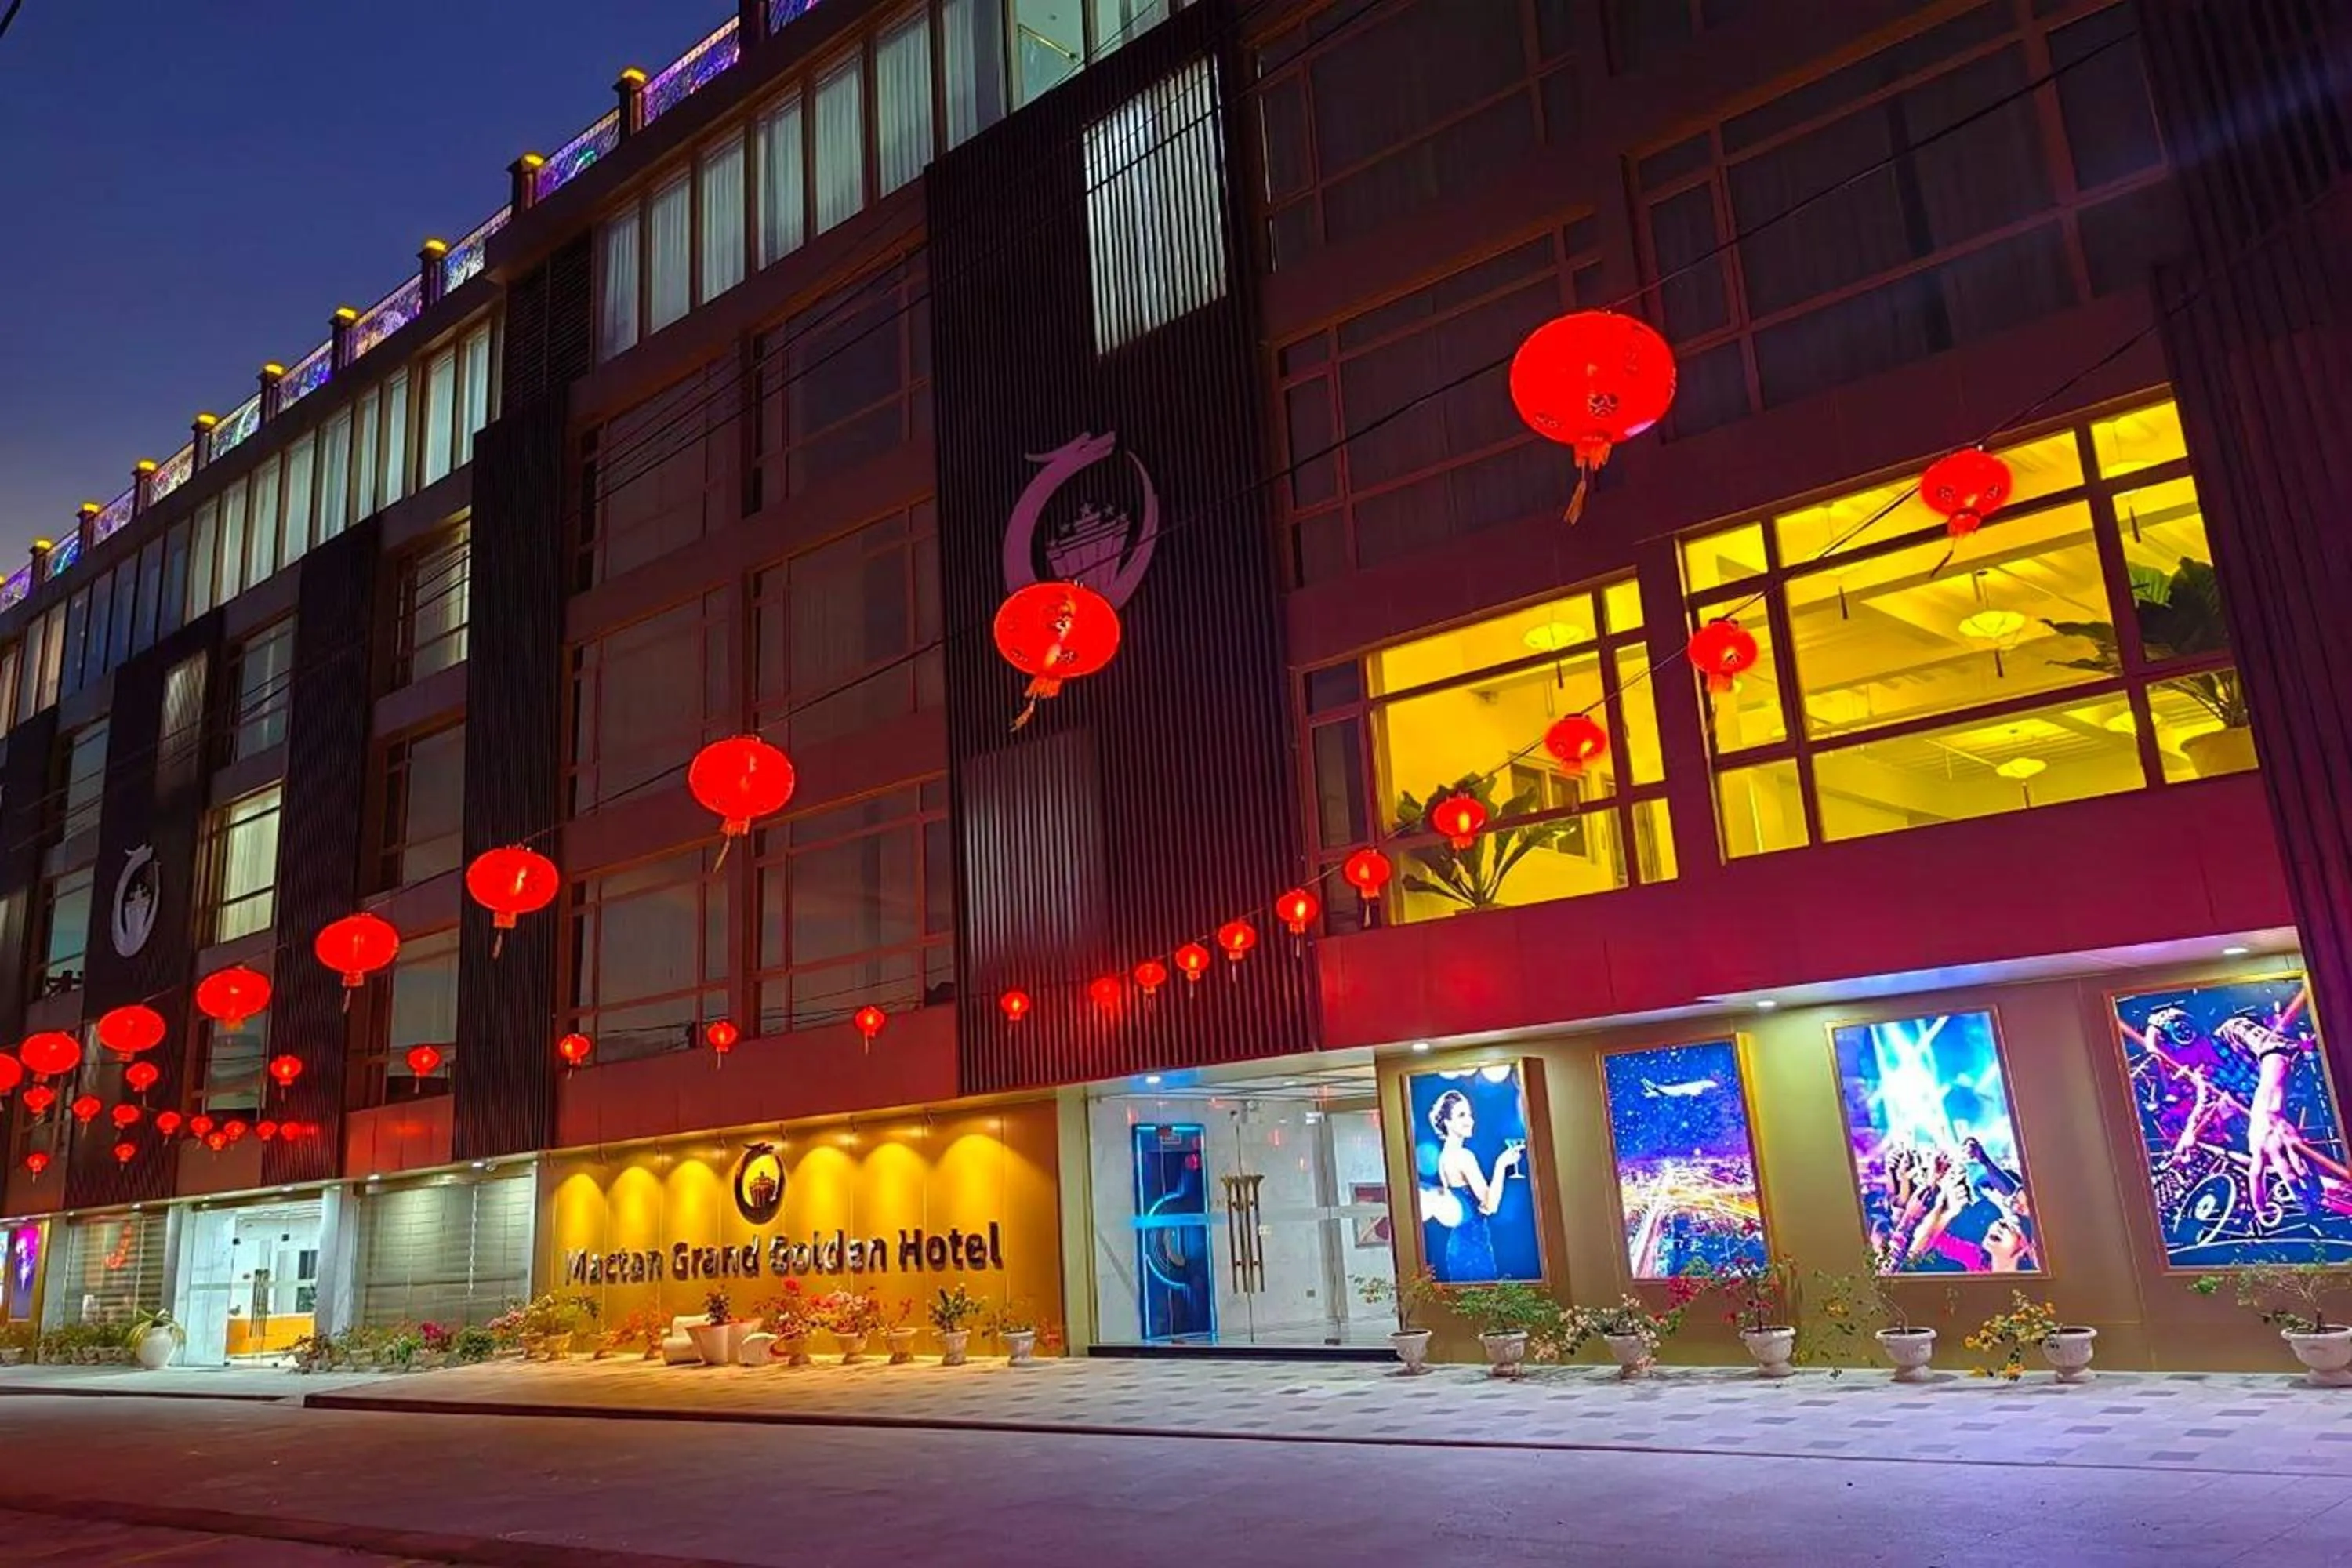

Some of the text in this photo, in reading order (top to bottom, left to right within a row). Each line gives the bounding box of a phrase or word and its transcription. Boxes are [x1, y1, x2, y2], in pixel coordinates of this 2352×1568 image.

[565, 1221, 1004, 1286] Mactan Grand Golden Hotel
